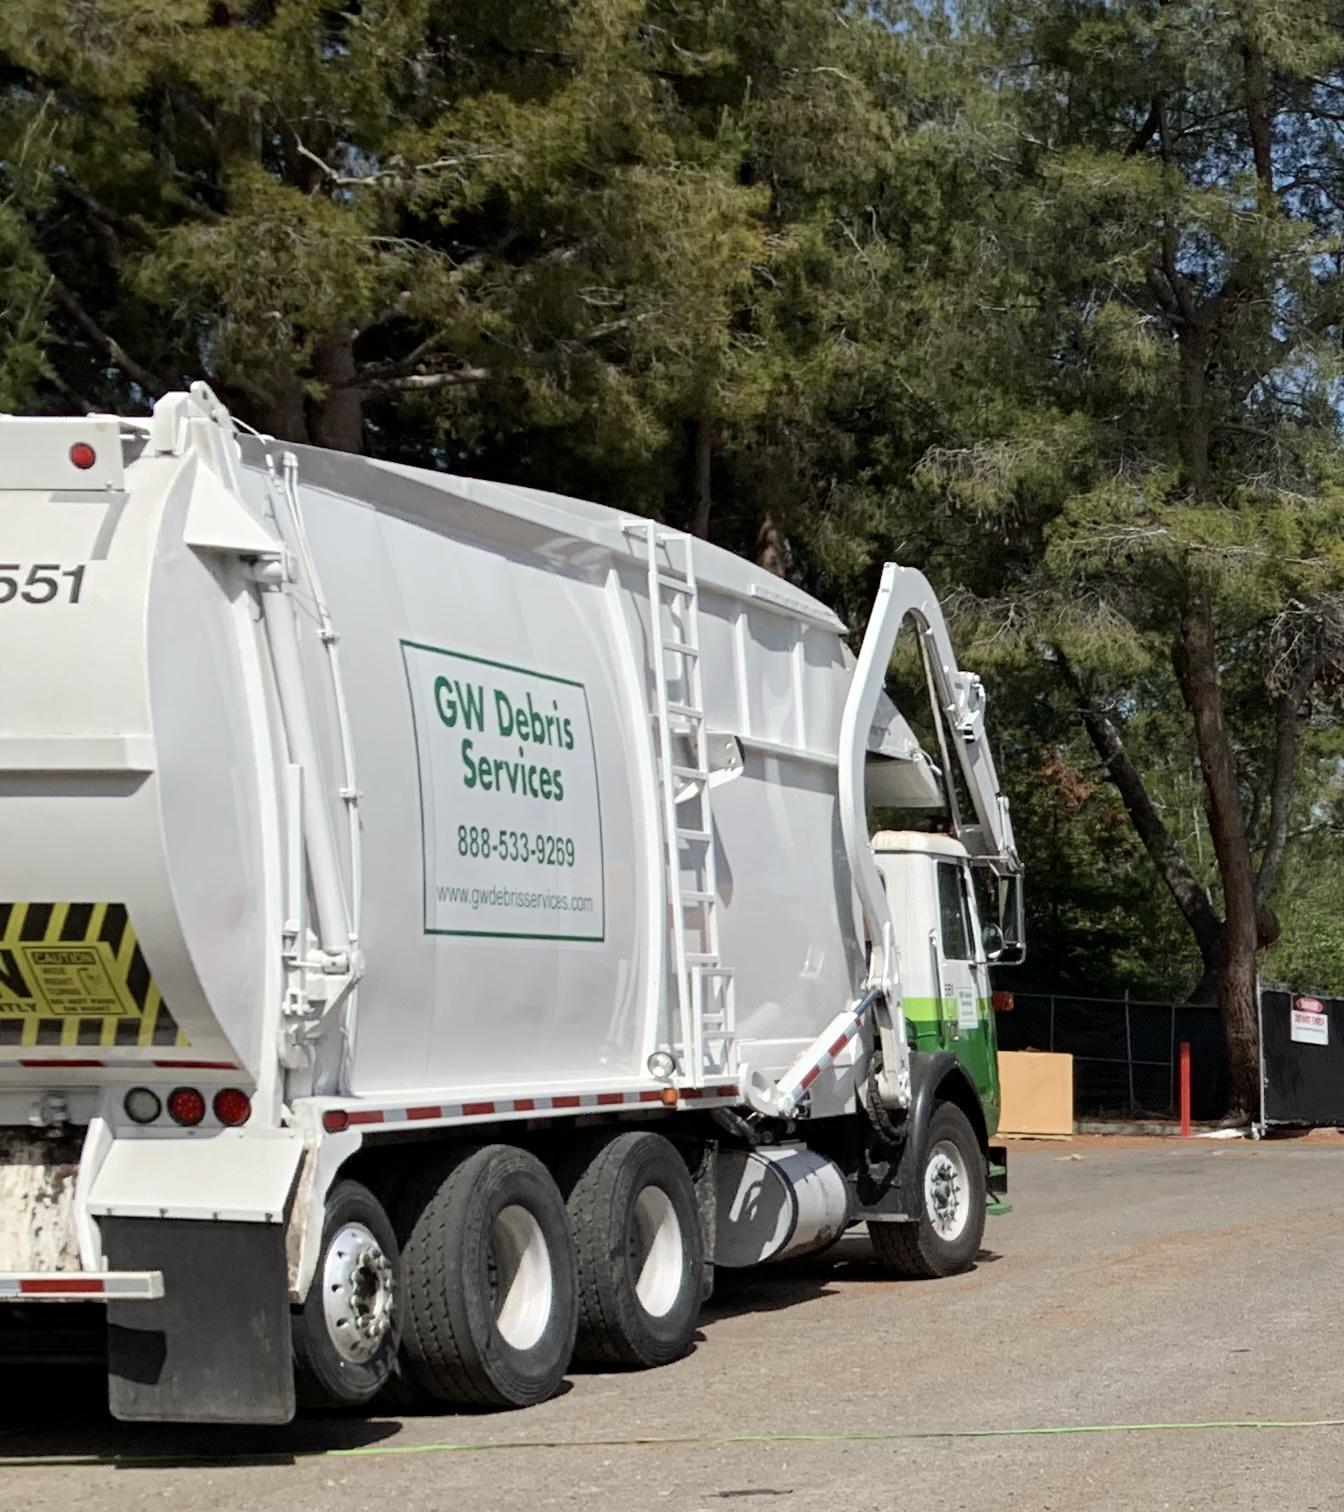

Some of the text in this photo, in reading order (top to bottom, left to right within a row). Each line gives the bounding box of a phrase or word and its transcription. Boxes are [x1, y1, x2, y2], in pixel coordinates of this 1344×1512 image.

[434, 675, 575, 751] GW Debris
[460, 738, 564, 802] Services
[457, 825, 576, 867] 888-533-9269
[436, 884, 594, 912] www.gwdebrisservices.com
